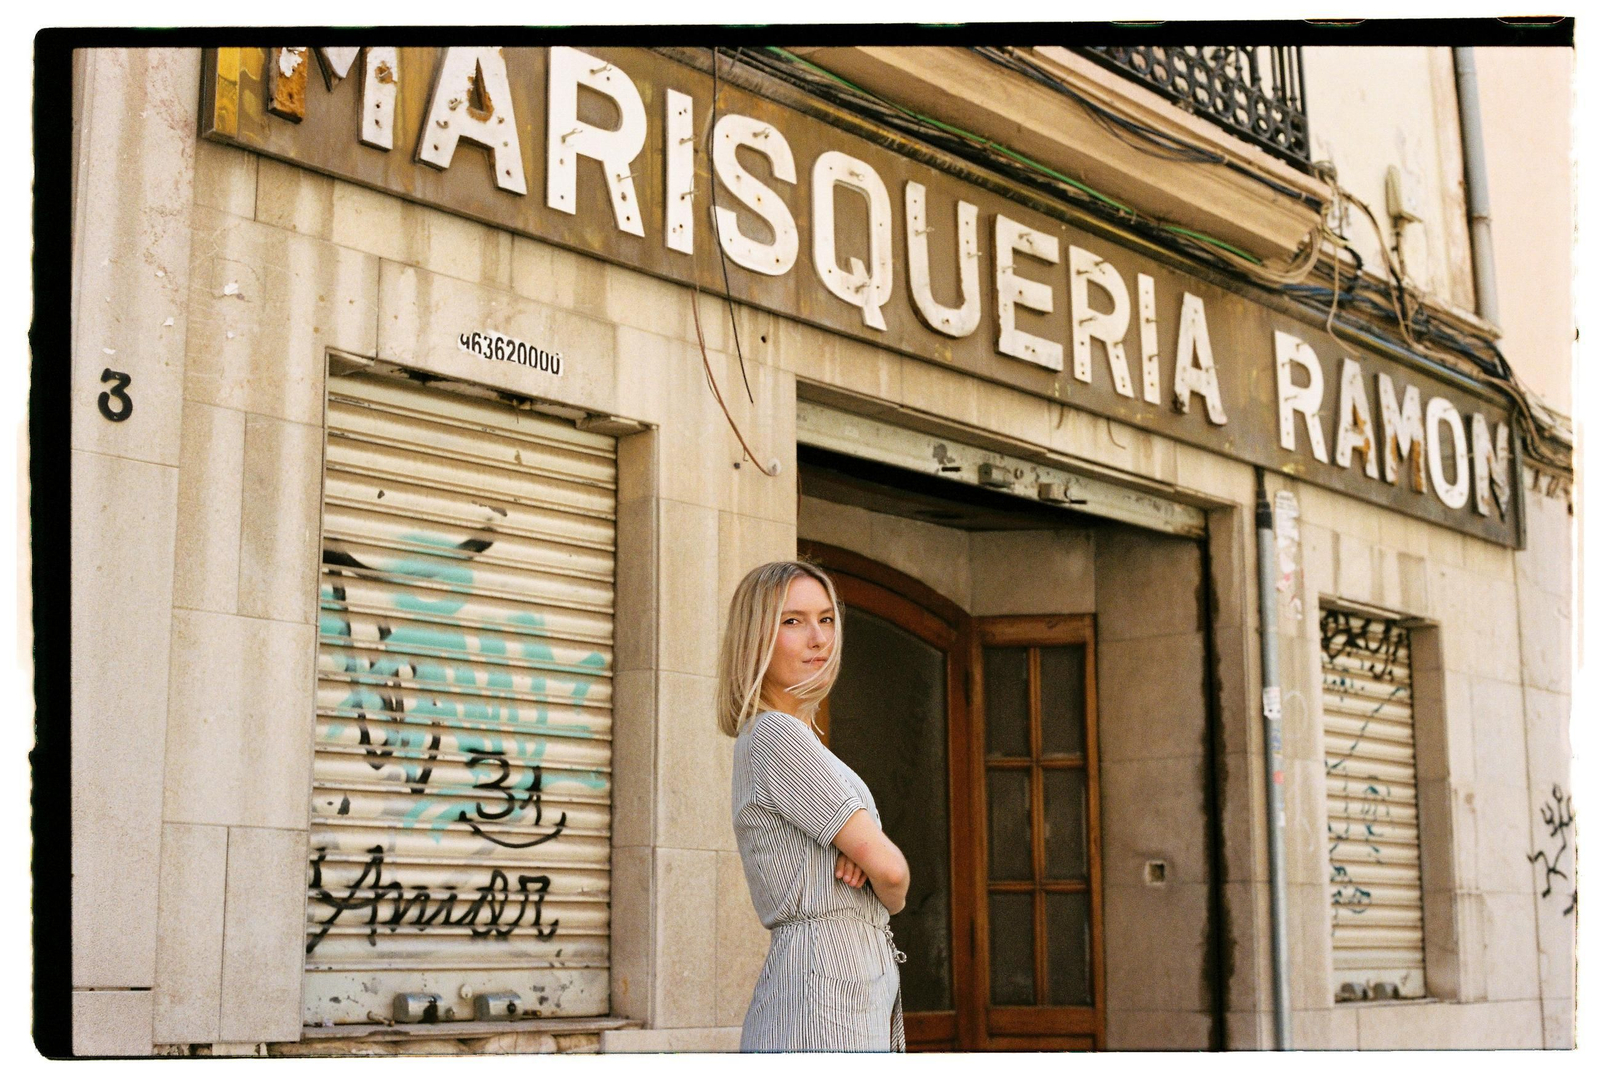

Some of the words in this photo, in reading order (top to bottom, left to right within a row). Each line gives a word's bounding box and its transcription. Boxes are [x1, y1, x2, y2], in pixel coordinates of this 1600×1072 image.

[98, 368, 133, 422] 3
[268, 46, 1227, 425] MARISQUERIA
[1274, 329, 1510, 521] RAMON
